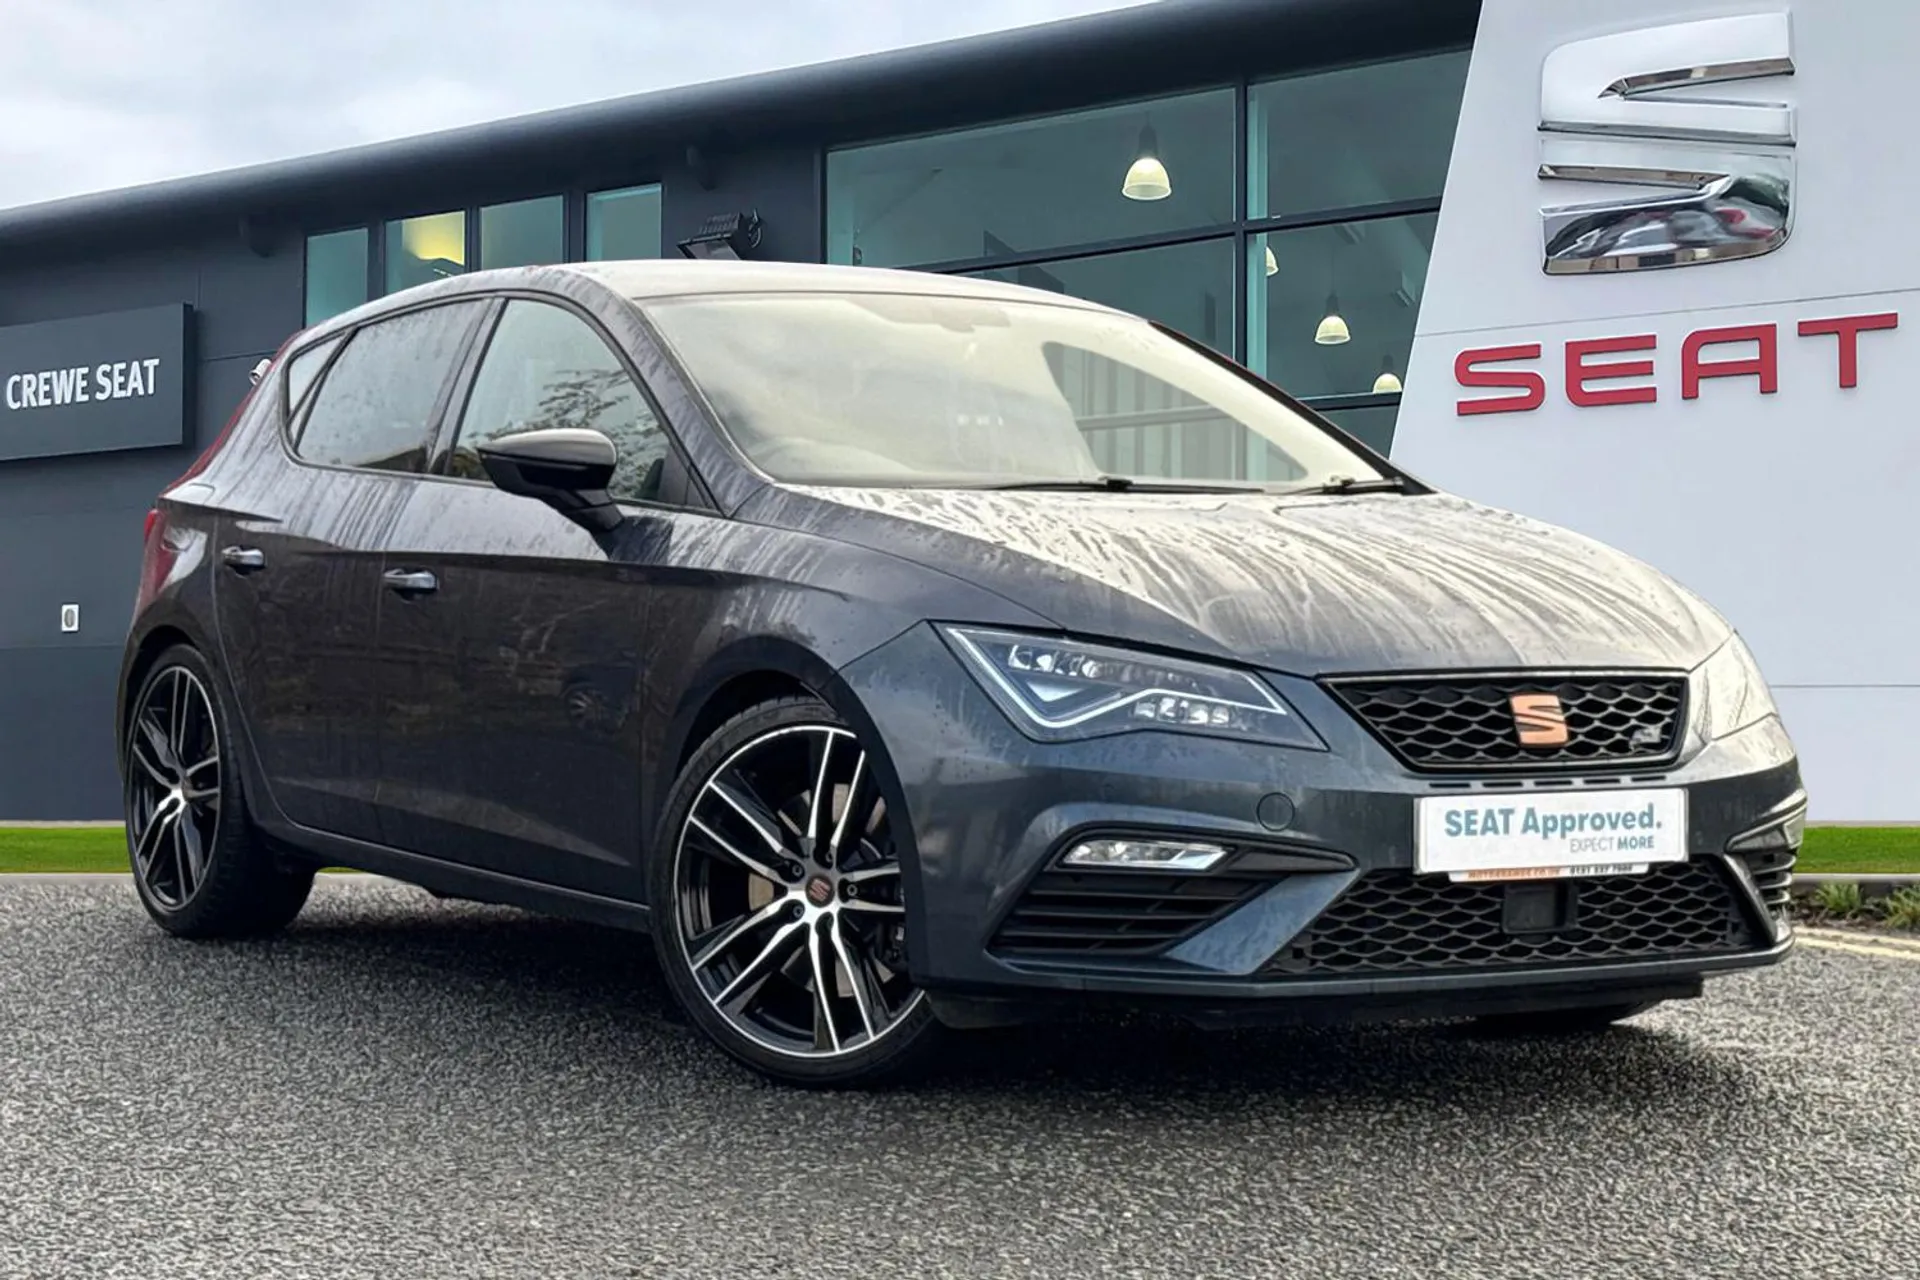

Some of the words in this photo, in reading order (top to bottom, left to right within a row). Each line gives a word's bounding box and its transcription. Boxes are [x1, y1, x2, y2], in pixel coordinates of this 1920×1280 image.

[6, 366, 90, 410] CREWE
[95, 358, 160, 401] SEAT
[1454, 312, 1898, 416] SEAT
[1444, 808, 1515, 837] SEAT
[1521, 803, 1662, 840] Approved.
[1569, 837, 1614, 853] EXPECT
[1617, 836, 1655, 851] MORE
